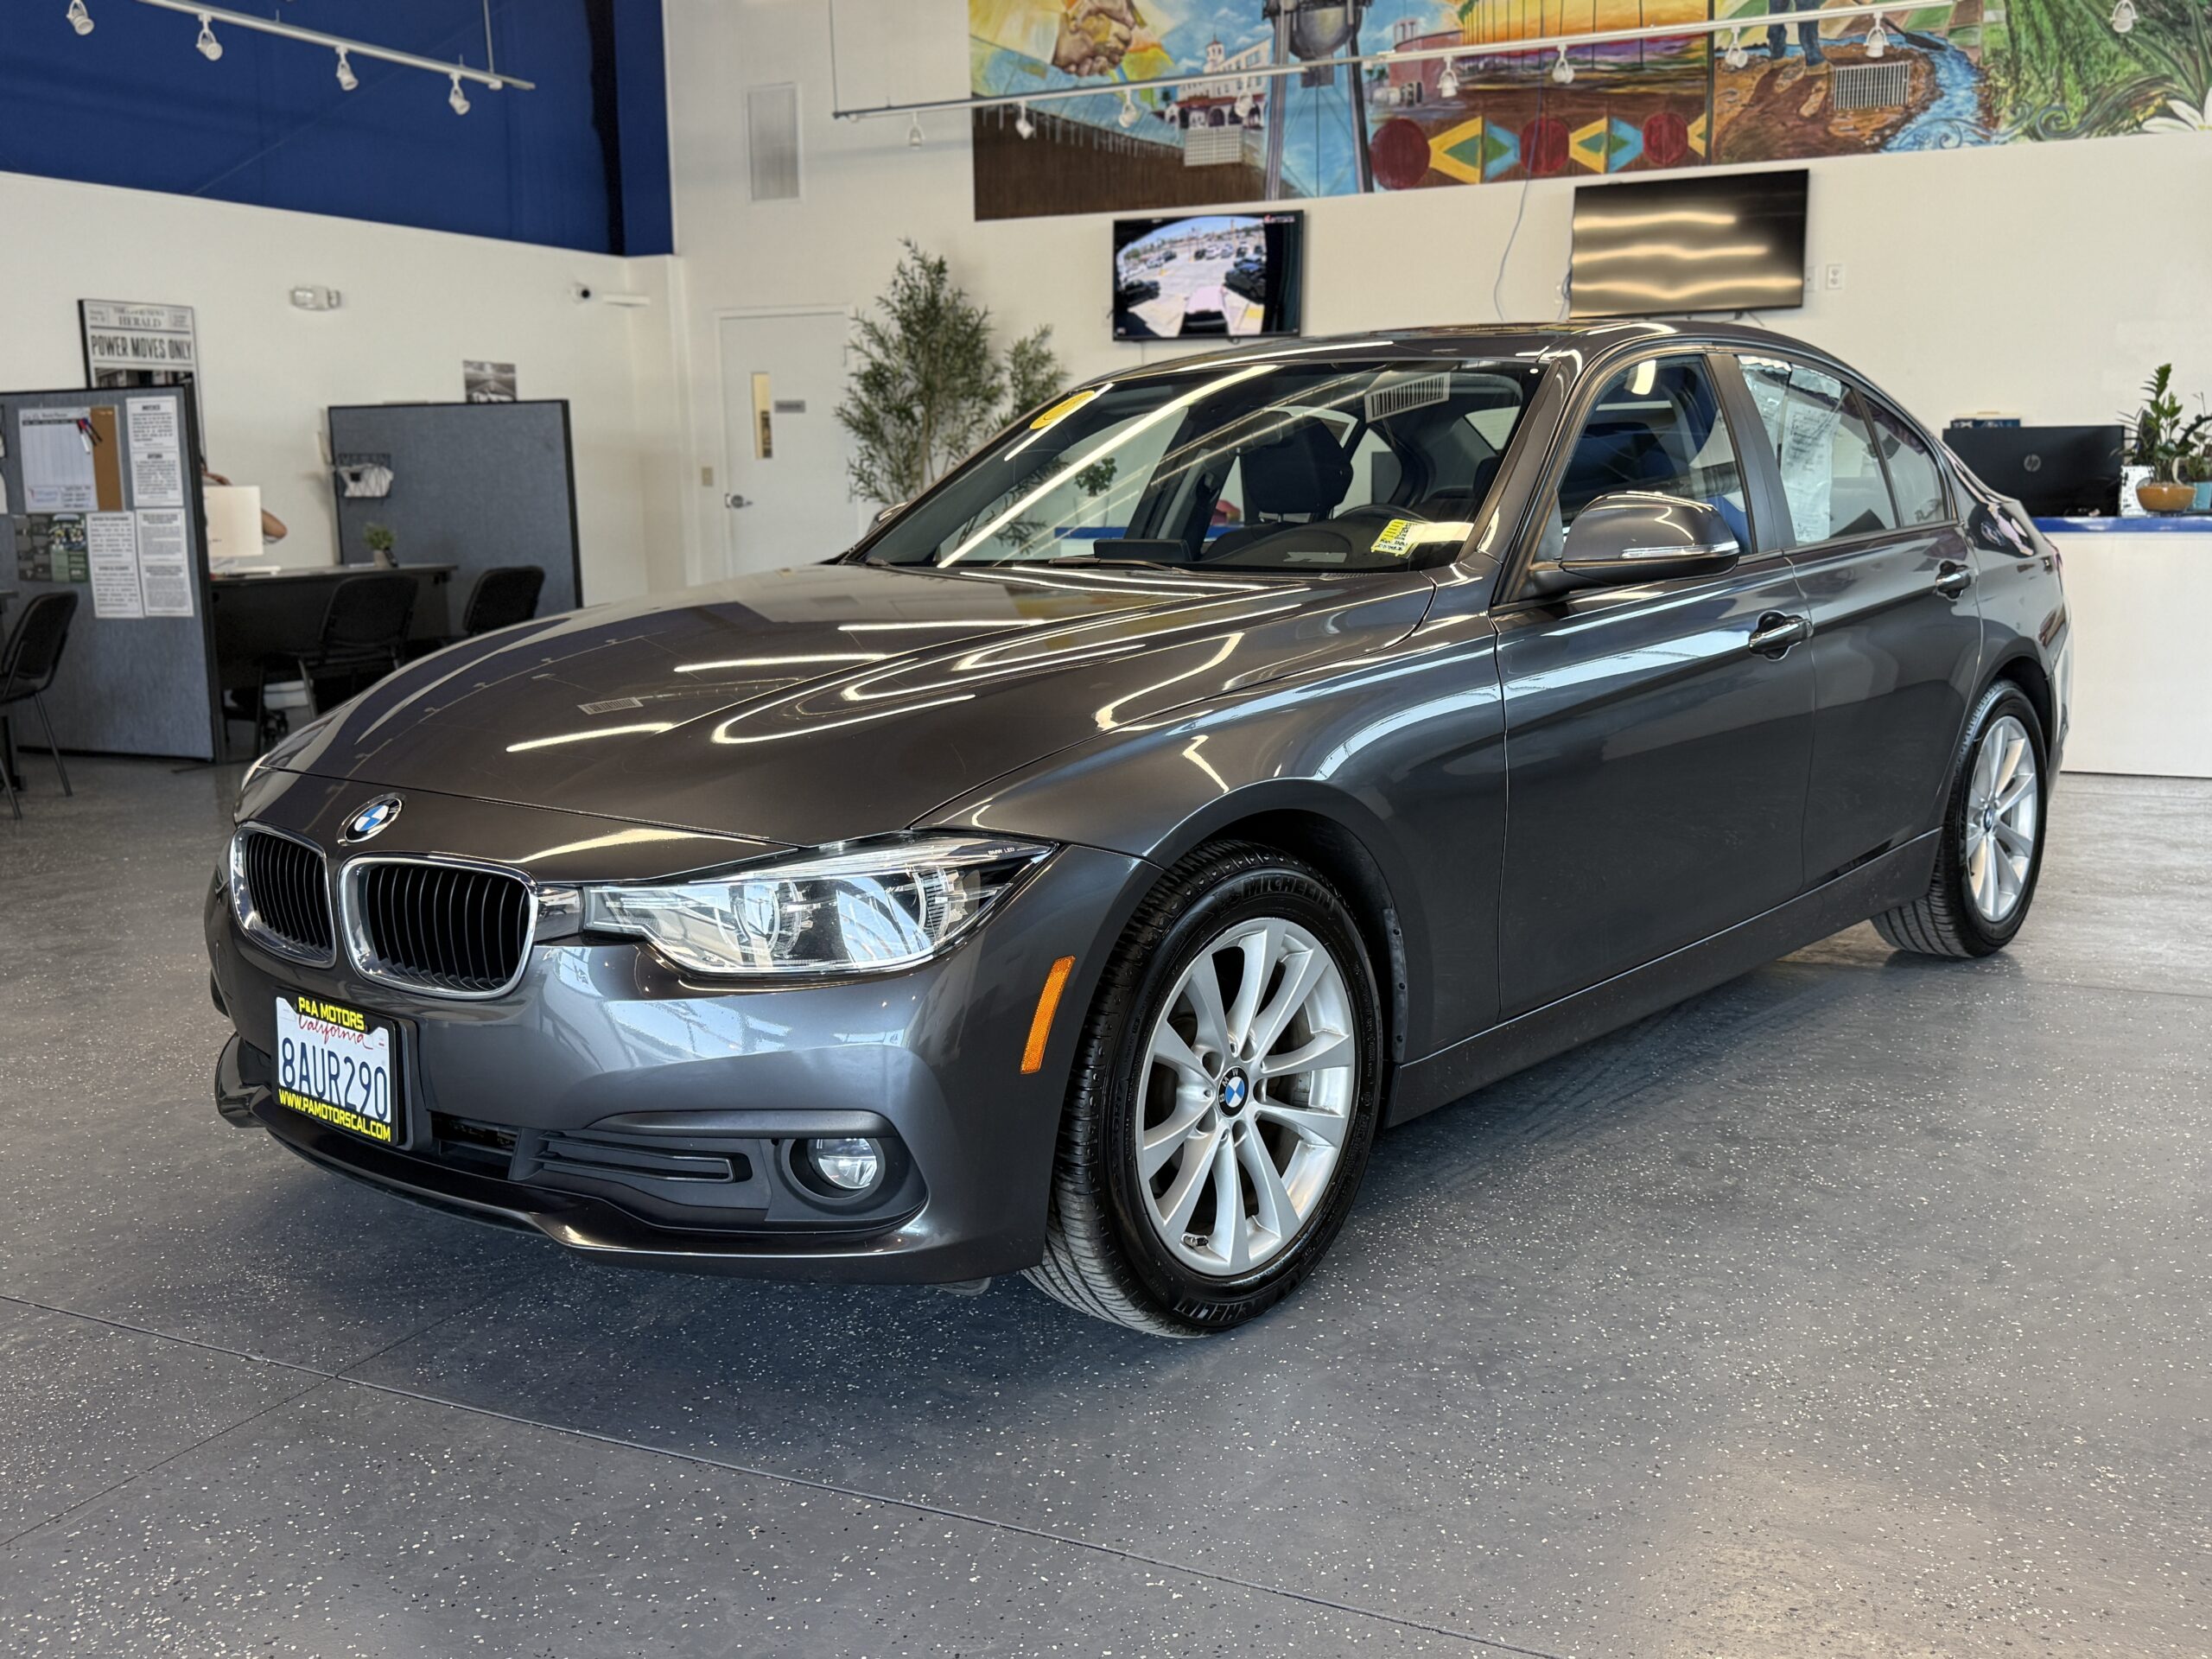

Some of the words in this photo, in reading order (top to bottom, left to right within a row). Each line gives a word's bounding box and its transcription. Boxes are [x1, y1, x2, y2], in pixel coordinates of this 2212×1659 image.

[118, 316, 162, 327] HERALD
[91, 334, 129, 357] POWER
[130, 336, 166, 359] MOVES
[168, 339, 192, 360] ONLY
[1243, 874, 1336, 911] MICHELIN
[298, 996, 319, 1018] P&A
[320, 1002, 365, 1031] MOTORS
[282, 1037, 388, 1122] 8AUR290
[1218, 1068, 1240, 1103] BMW
[278, 1088, 391, 1142] WWW.PAMOTORSCAL.COM
